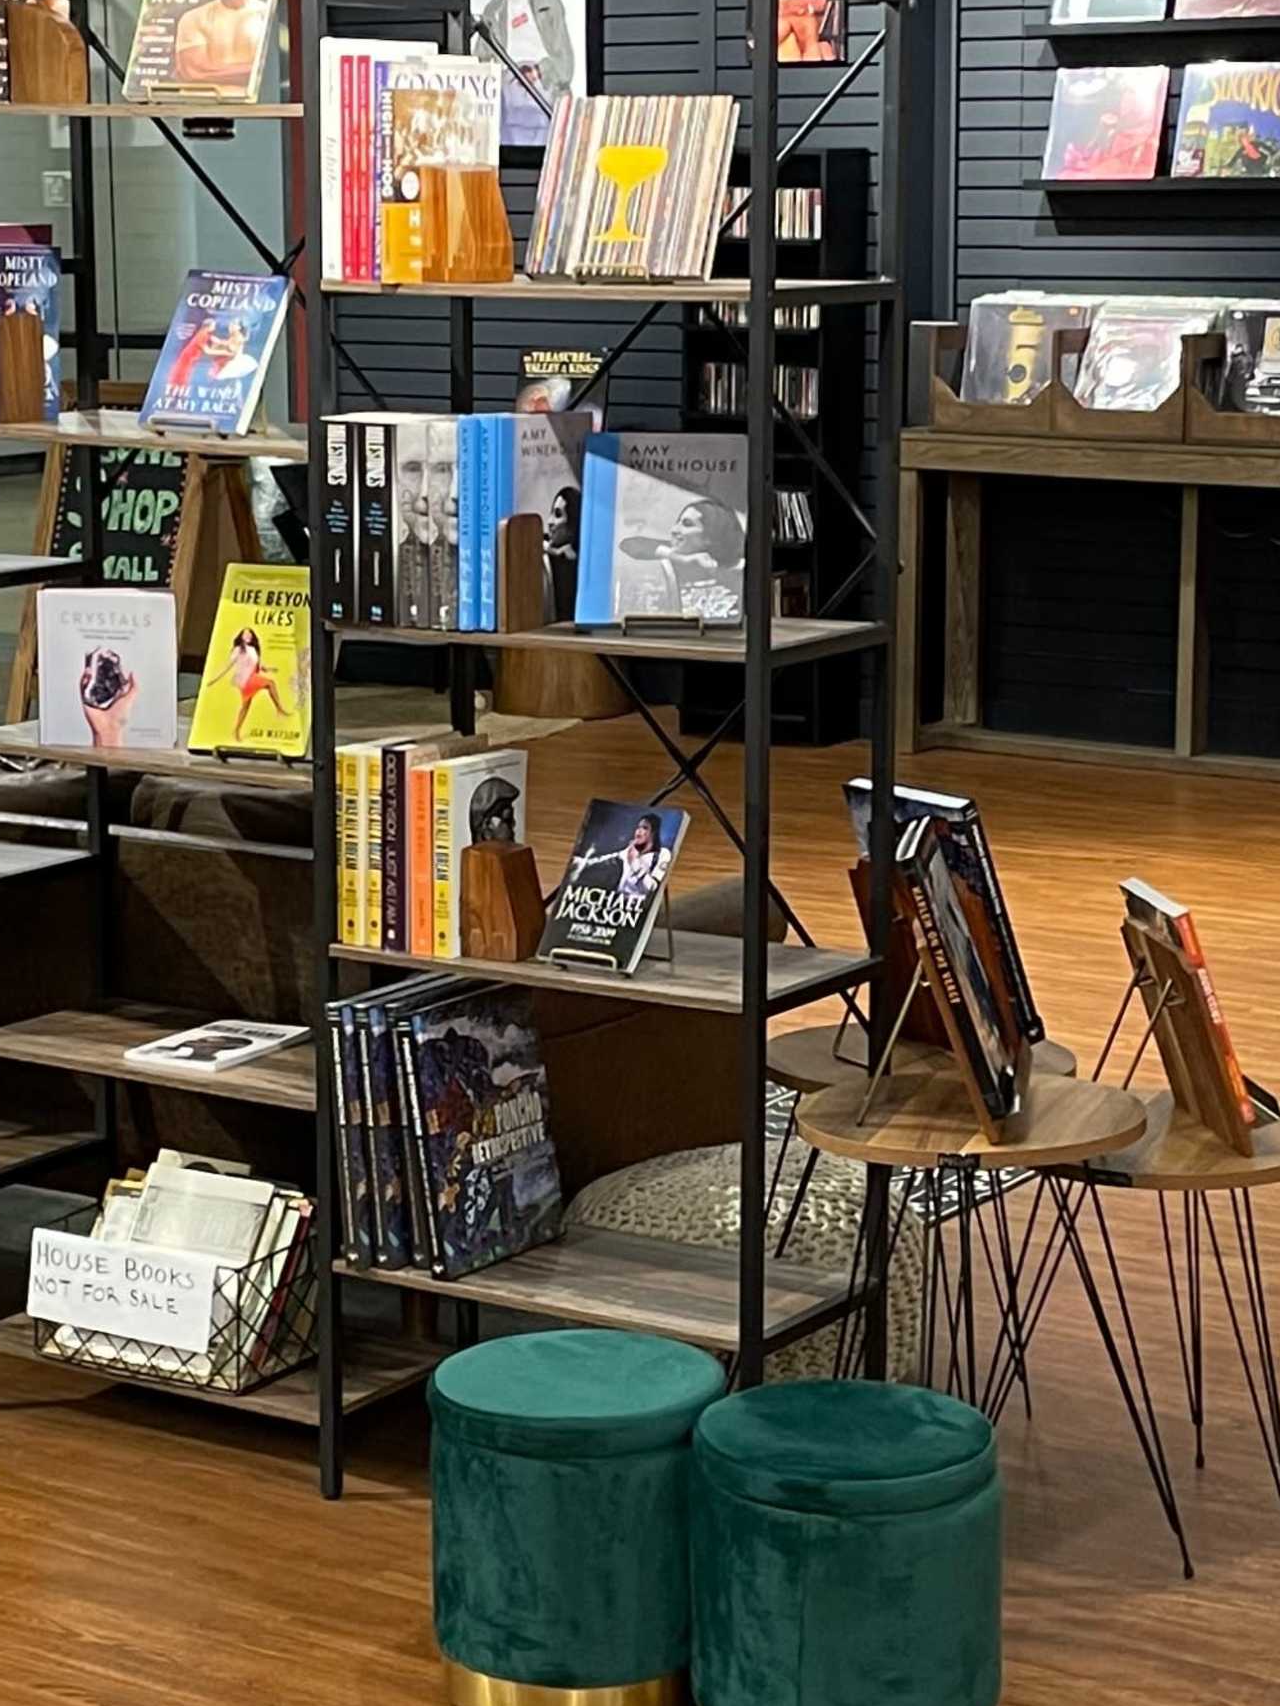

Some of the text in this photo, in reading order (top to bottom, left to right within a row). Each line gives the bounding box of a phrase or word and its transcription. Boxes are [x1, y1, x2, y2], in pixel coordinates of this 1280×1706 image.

[395, 73, 497, 100] COOKING
[382, 91, 394, 198] HIGH HOG
[5, 255, 44, 270] MISTY
[211, 281, 263, 295] MISTY
[187, 293, 277, 311] COPELAND
[165, 384, 192, 398] THE
[154, 397, 238, 415] AT MY BACK
[522, 429, 547, 441] AMY
[629, 444, 671, 456] AMY
[630, 459, 738, 473] WINEHOUSE
[233, 589, 311, 608] LIFE BEYON
[60, 611, 153, 629] CRYSTALS
[254, 610, 296, 627] LIKES
[562, 884, 646, 913] MICHAEL
[554, 897, 640, 928] JACKSON
[35, 1239, 196, 1290] HOUSE BOOKS
[32, 1274, 180, 1316] NOT FOR SALE
